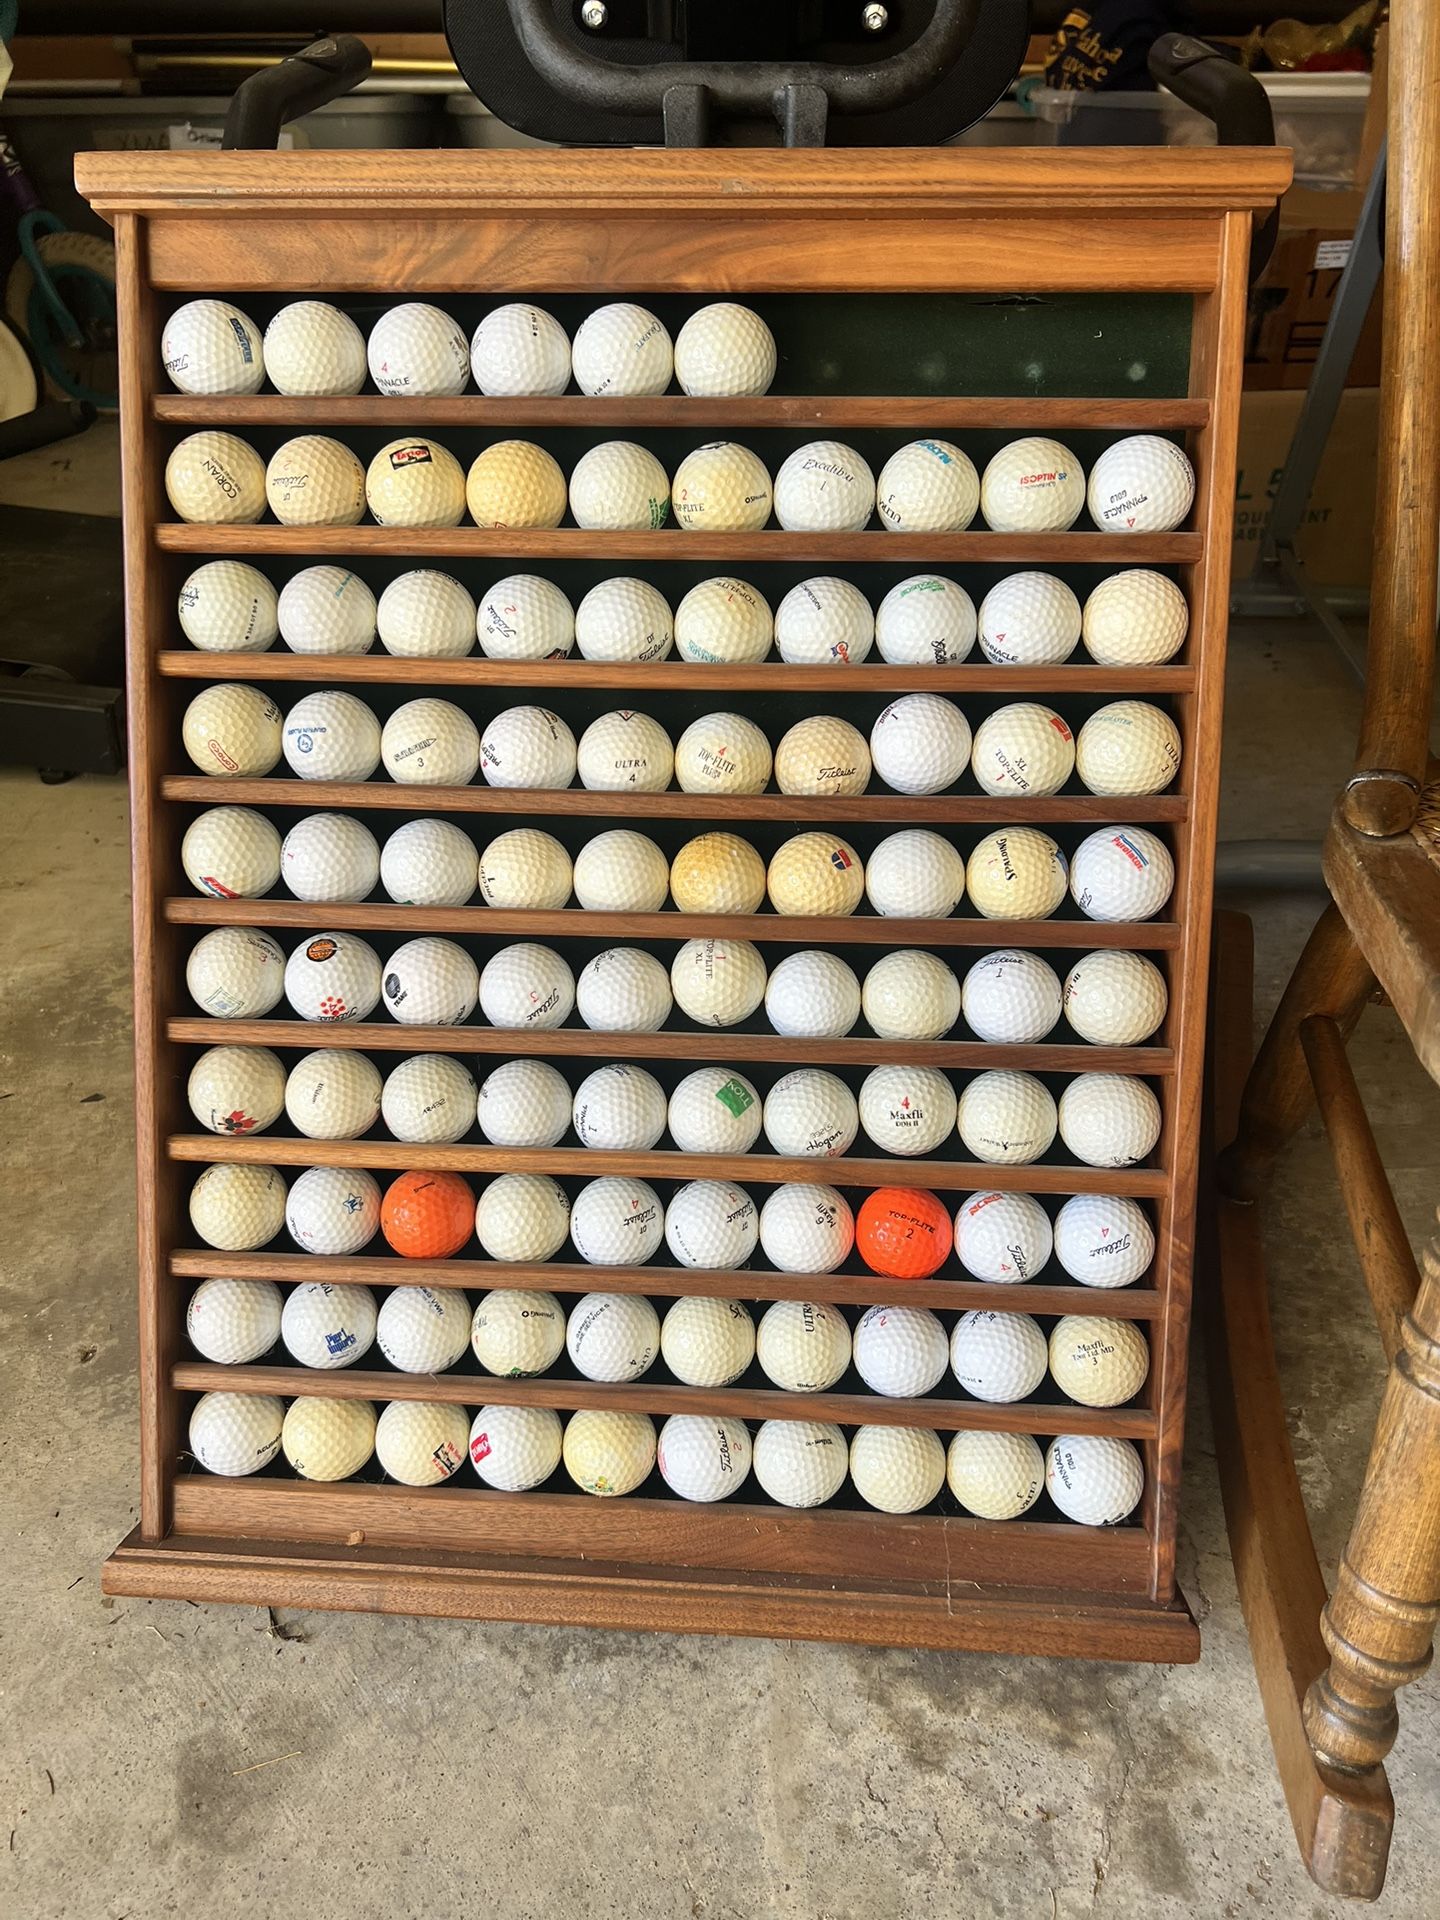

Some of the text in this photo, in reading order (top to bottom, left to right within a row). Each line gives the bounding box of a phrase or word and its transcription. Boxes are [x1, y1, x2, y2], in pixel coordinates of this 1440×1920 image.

[202, 460, 237, 499] CORIAN
[1020, 473, 1056, 484] ISOPTIN
[820, 481, 826, 491] 1
[682, 489, 688, 500] 2
[888, 494, 894, 504] 3
[1110, 490, 1128, 503] GOLD
[1104, 494, 1148, 519] PINNACLE
[682, 515, 693, 523] XL
[996, 633, 1007, 643] 4
[639, 633, 669, 661] Titleist
[982, 634, 1019, 662] PINNACLE
[718, 746, 727, 756] 4
[417, 757, 425, 767] 3
[615, 759, 647, 768] ULTRA
[697, 748, 736, 774] TOP-FLITE
[1015, 757, 1027, 771] XL
[817, 767, 857, 781] Titleist
[995, 749, 1030, 790] TOP-FLITE
[1161, 764, 1169, 773] 3
[629, 774, 636, 783] 4
[996, 774, 1005, 782] 1
[835, 783, 841, 793] 1
[997, 838, 1017, 881] SPALDING
[1111, 836, 1144, 872] Purolator
[695, 952, 703, 964] XL
[980, 957, 1025, 969] Titleist
[996, 968, 1003, 977] 1
[527, 988, 560, 1021] Titleist
[727, 1081, 751, 1108] KOLL
[901, 1096, 910, 1109] 4
[890, 1109, 924, 1120] Maxfli
[806, 1129, 843, 1151] Hogan
[632, 1199, 639, 1209] 4
[623, 1206, 656, 1226] Titleist
[815, 1203, 836, 1228] Maxfli
[888, 1210, 935, 1234] TOP-FLITE
[905, 1228, 914, 1239] 2
[1102, 1227, 1109, 1237] 4
[1089, 1233, 1131, 1257] Titleist
[805, 1303, 814, 1333] ULTRA
[816, 1312, 826, 1320] 2
[880, 1315, 887, 1327] 2
[325, 1332, 342, 1346] Pier
[1078, 1340, 1104, 1354] Maxfli
[1100, 1345, 1115, 1355] MD
[1091, 1357, 1098, 1366] 3
[721, 1430, 732, 1472] Titleist
[733, 1443, 742, 1451] 2
[1054, 1446, 1072, 1490] PINNACLE
[1020, 1481, 1037, 1510] ULTRA
